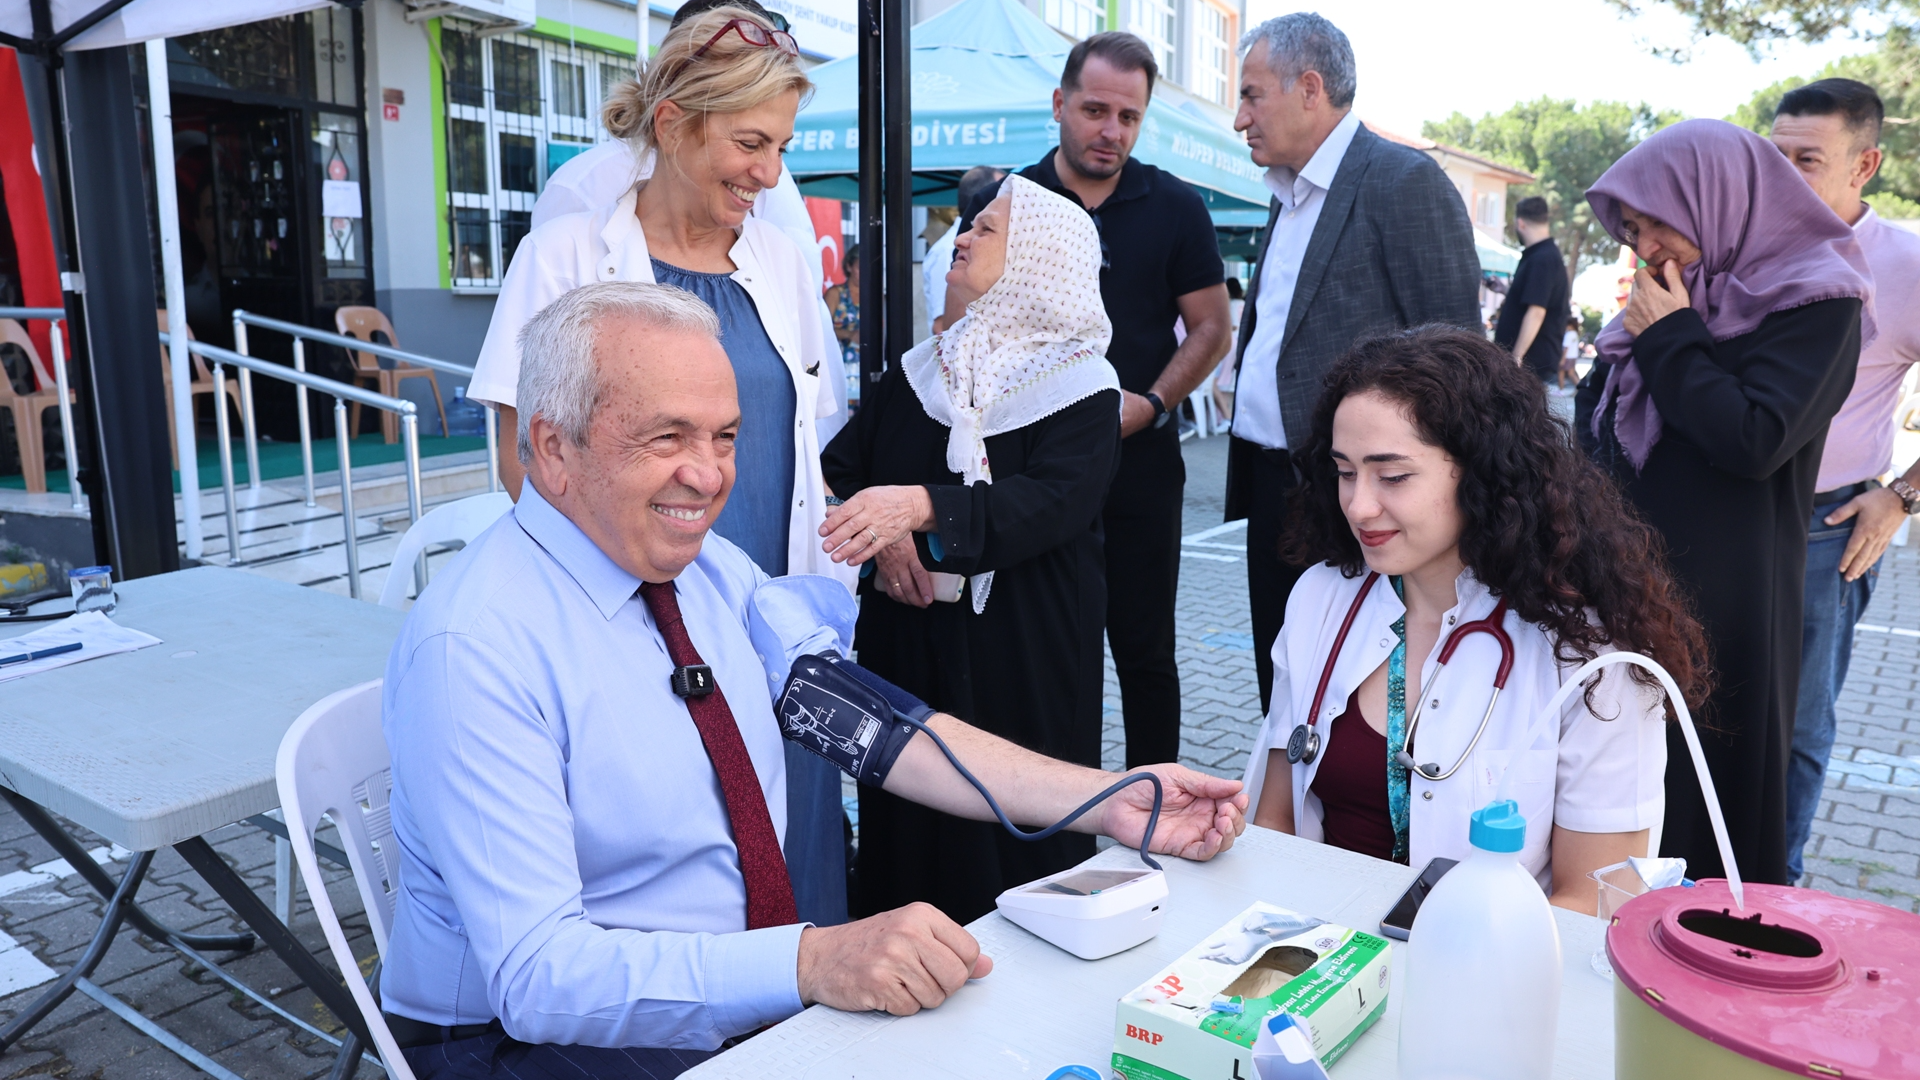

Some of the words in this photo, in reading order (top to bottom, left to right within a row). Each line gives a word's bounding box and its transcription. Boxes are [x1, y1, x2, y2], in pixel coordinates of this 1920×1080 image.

[788, 130, 835, 151] FER
[845, 117, 1007, 149] BDİYESİ
[1290, 984, 1315, 999] Lateks
[1331, 945, 1358, 965] Eldiveni
[1296, 1002, 1311, 1012] Free
[1305, 993, 1322, 1004] Latex
[1339, 963, 1357, 976] Gloves
[1358, 987, 1366, 1009] L
[1125, 1023, 1163, 1046] BRP
[1233, 1058, 1245, 1080] L
